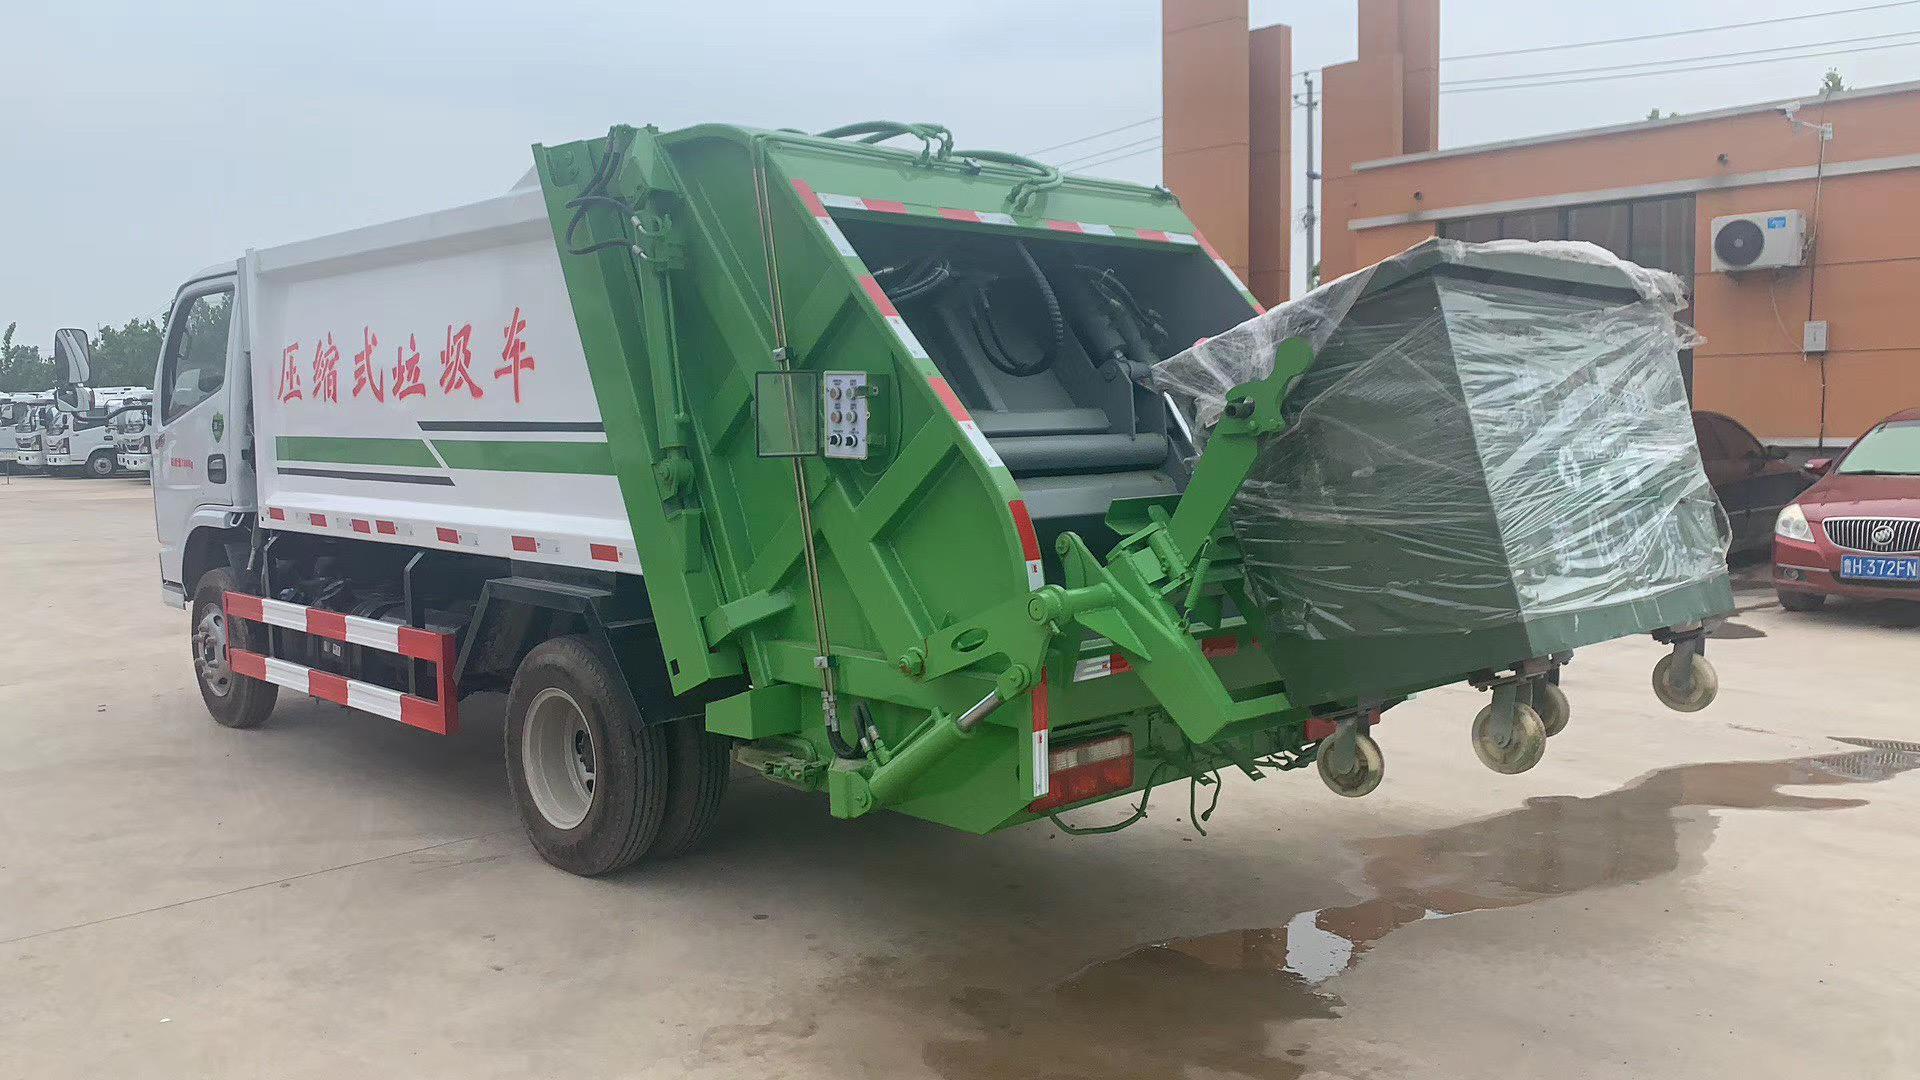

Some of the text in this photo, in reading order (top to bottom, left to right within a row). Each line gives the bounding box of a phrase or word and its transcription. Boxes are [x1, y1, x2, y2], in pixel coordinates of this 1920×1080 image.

[277, 306, 535, 404] 压缩式垃圾车
